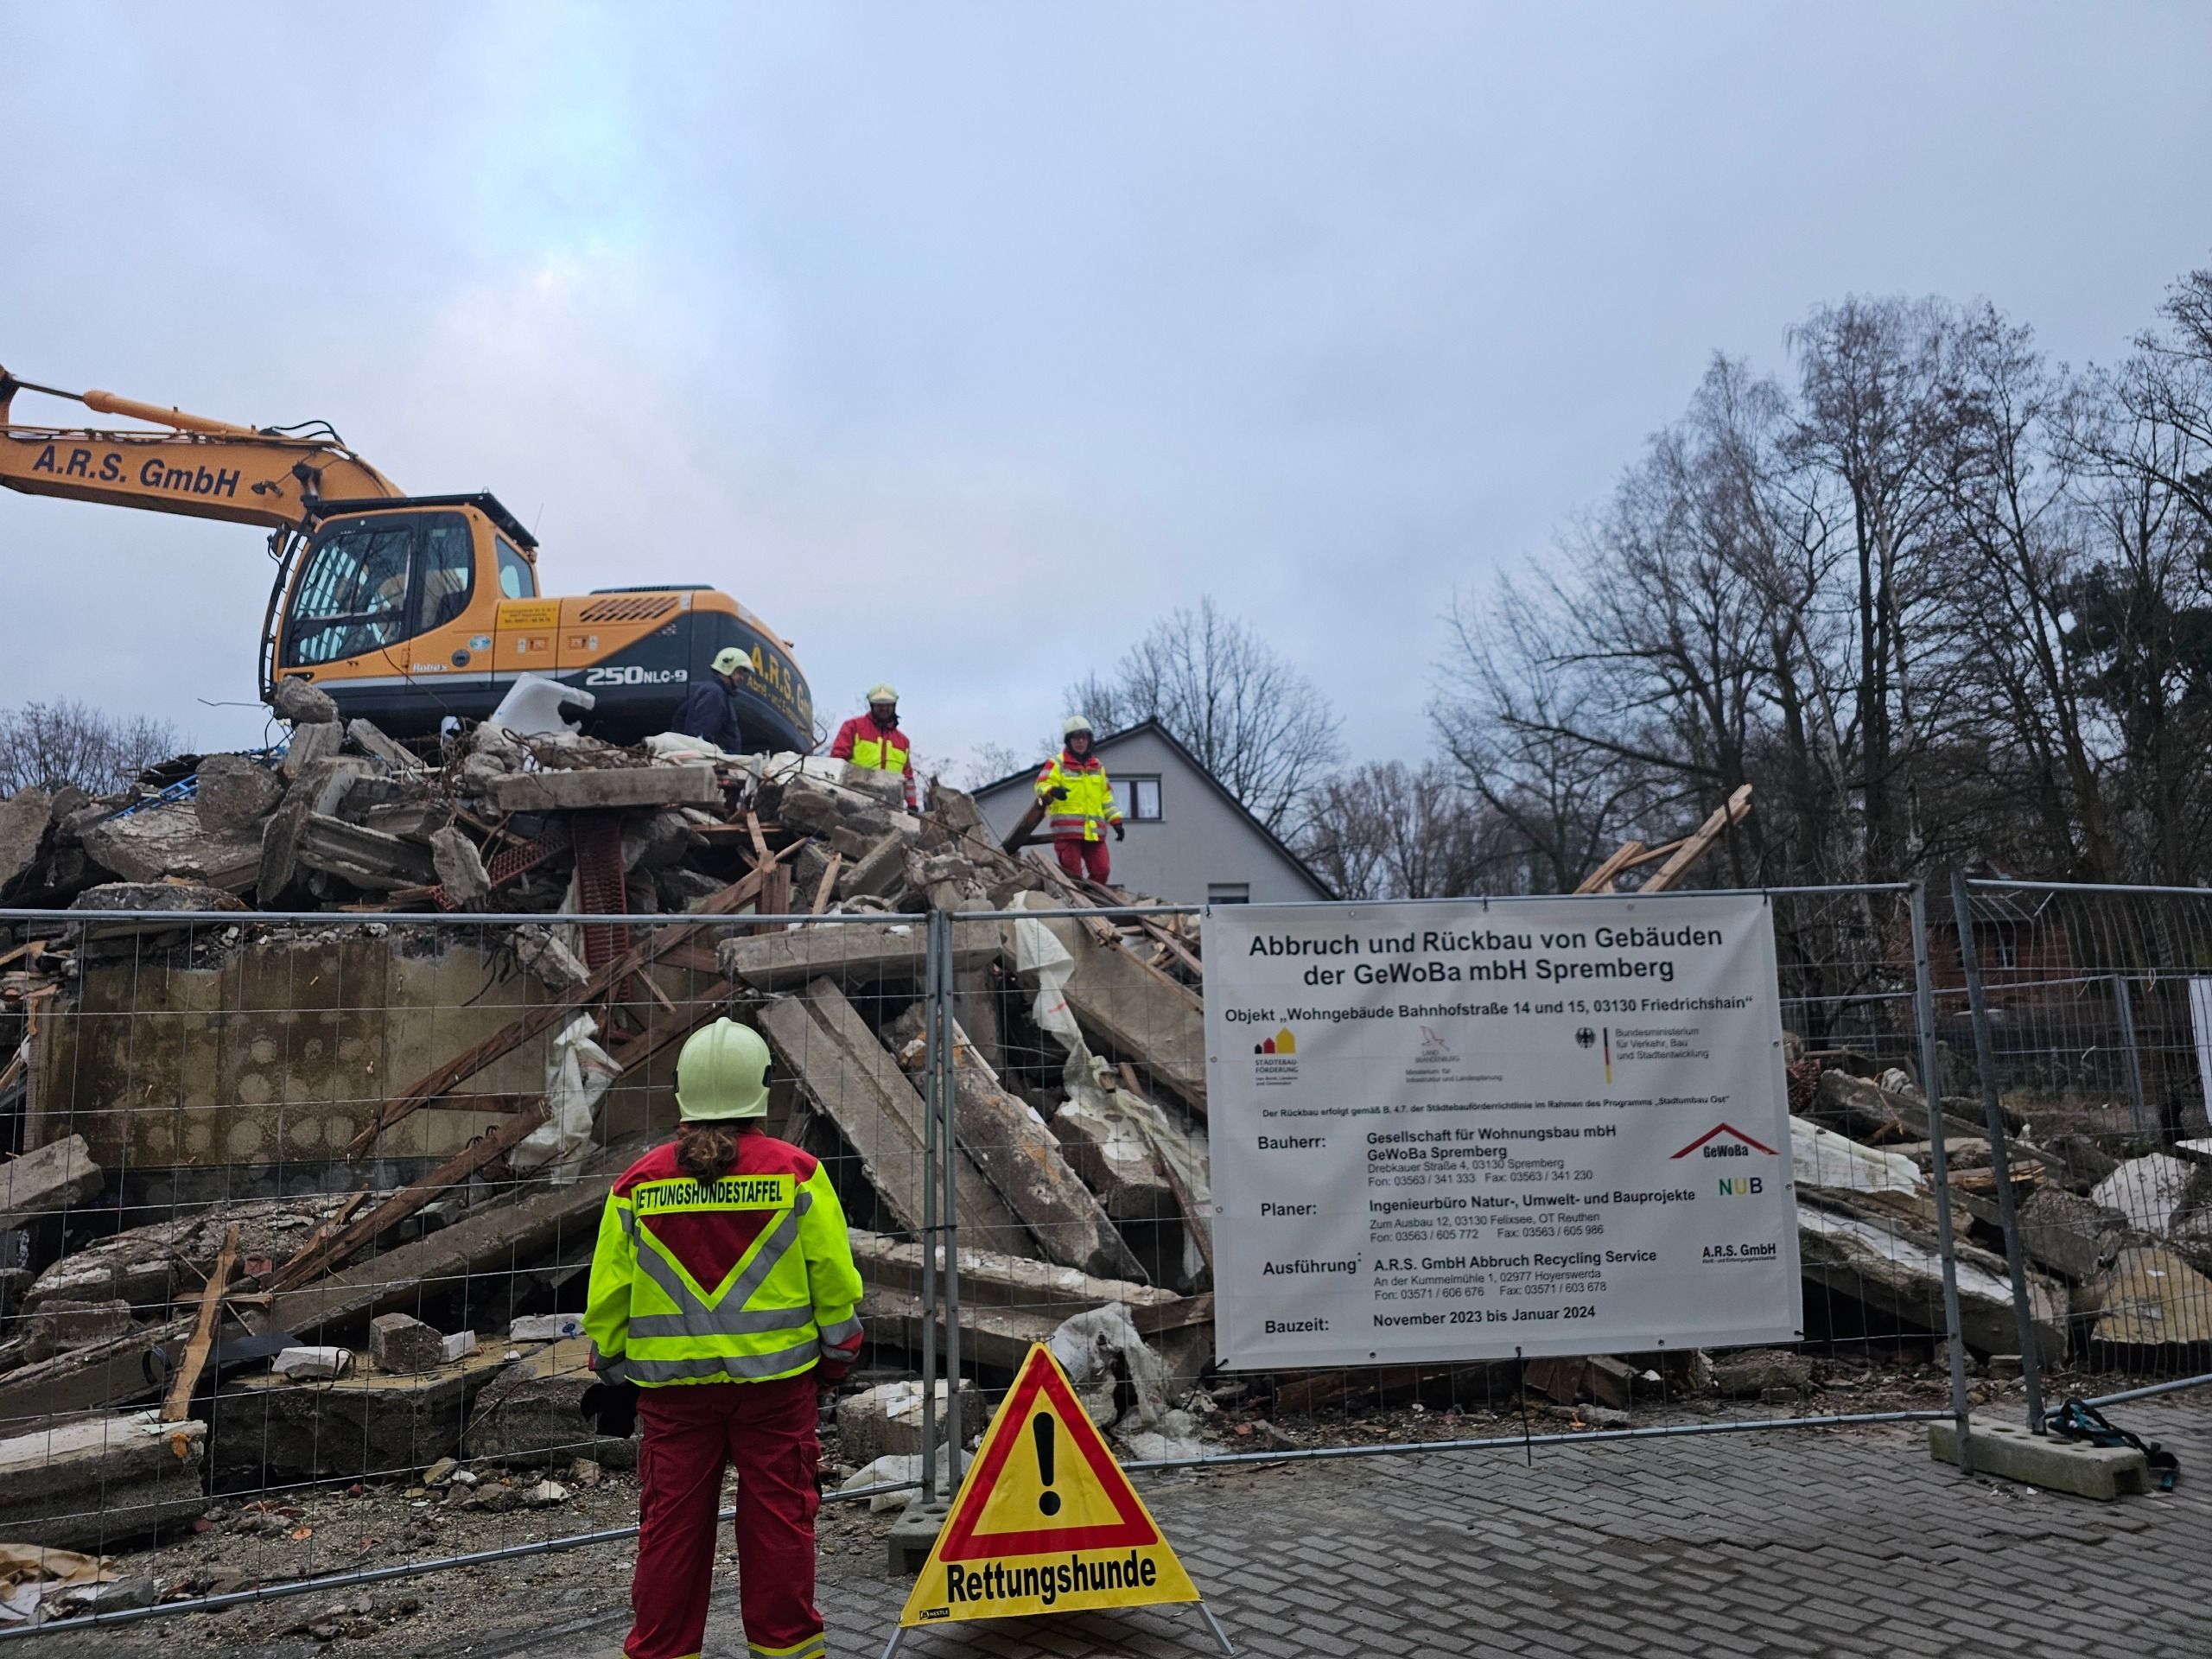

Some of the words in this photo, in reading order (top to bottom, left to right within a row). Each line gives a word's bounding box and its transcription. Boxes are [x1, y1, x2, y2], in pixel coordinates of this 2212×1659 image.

[33, 445, 126, 483] A.R.S.
[140, 459, 241, 498] GmbH
[750, 643, 795, 704] A.R.S.
[1249, 935, 1358, 956] Abbruch
[1370, 932, 1414, 953] und
[1423, 931, 1532, 951] Rückbau
[1541, 933, 1586, 949] von
[1595, 926, 1721, 947] Gebäuden
[1304, 965, 1345, 985] der
[1354, 962, 1461, 984] GeWoBa
[1470, 960, 1526, 981] mbH
[1536, 957, 1673, 983] Spremberg
[1225, 1009, 1274, 1024] Objekt
[1281, 1006, 1394, 1023] „Wohngebäude
[1399, 1002, 1508, 1017] Bahnhofstraße
[1514, 1002, 1530, 1014] 14
[1535, 1001, 1563, 1014] und
[1568, 1001, 1589, 1014] 15,
[1594, 1000, 1636, 1012] 03130
[1617, 1039, 1628, 1048] für
[1670, 1039, 1688, 1047] Bau
[1618, 1052, 1634, 1060] und
[1281, 1109, 1319, 1117] Rückbau
[1321, 1107, 1349, 1116] erfolgt
[1351, 1106, 1381, 1116] gemäß
[1603, 1099, 1652, 1108] Programms
[1258, 1135, 1325, 1149] Bauherr:
[1367, 1130, 1452, 1144] Gesellschaft
[1455, 1128, 1474, 1141] für
[1478, 1127, 1580, 1141] Wohnungsbau
[1584, 1125, 1616, 1137] mbH
[1368, 1147, 1427, 1160] GeWoBa
[1431, 1146, 1507, 1161] Spremberg
[1703, 1145, 1749, 1158] GeWoBa
[1368, 1163, 1421, 1173] Drebkauer
[1423, 1160, 1457, 1171] Straße
[1459, 1160, 1469, 1171] 4,
[1472, 1160, 1504, 1170] 03130
[1508, 1158, 1564, 1170] Spremberg
[1369, 1177, 1390, 1186] Fon:
[1394, 1175, 1425, 1185] 03563
[1434, 1174, 1452, 1184] 341
[1456, 1173, 1476, 1183] 333
[1484, 1173, 1507, 1182] Fax:
[1510, 1171, 1542, 1182] 03563
[1552, 1171, 1569, 1180] 341
[1573, 1170, 1592, 1180] 230
[1719, 1178, 1763, 1195] NUB
[1262, 1203, 1316, 1216] Planer:
[1370, 1198, 1466, 1214] Ingenieurbüro
[1471, 1196, 1518, 1208] Natur-,
[1523, 1194, 1580, 1206] Umwelt-
[1585, 1192, 1609, 1205] und
[1613, 1189, 1694, 1205] Bauprojekte
[1370, 1219, 1392, 1229] Zum
[1395, 1217, 1433, 1228] Ausbau
[1437, 1217, 1452, 1227] 12,
[1454, 1216, 1487, 1226] 03130
[1539, 1213, 1555, 1224] OT
[1558, 1212, 1599, 1223] Reuthen
[1370, 1233, 1392, 1243] Fon:
[1395, 1231, 1427, 1242] 03563
[1436, 1230, 1456, 1240] 605
[1459, 1229, 1478, 1239] 772
[1497, 1228, 1520, 1238] Fax:
[1522, 1226, 1554, 1237] 03563
[1564, 1226, 1583, 1236] 605
[1586, 1224, 1604, 1235] 986
[1703, 1246, 1737, 1257] A.R.S.
[1740, 1243, 1776, 1255] GmbH
[1375, 1258, 1416, 1271] A.R.S.
[1421, 1256, 1465, 1269] GmbH
[1470, 1255, 1529, 1268] Abbruch
[1535, 1252, 1600, 1268] Recycling
[1605, 1250, 1656, 1262] Service
[1374, 1277, 1388, 1287] An
[1391, 1276, 1408, 1286] der
[1489, 1273, 1497, 1283] 1,
[1500, 1272, 1532, 1282] 02977
[1535, 1269, 1601, 1282] Hoyerswerda
[1375, 1290, 1397, 1300] Fon:
[1401, 1288, 1433, 1300] 03571
[1442, 1287, 1461, 1298] 606
[1465, 1287, 1484, 1297] 676
[1499, 1285, 1522, 1295] Fax:
[1524, 1284, 1555, 1294] 03571
[1565, 1283, 1585, 1293] 603
[1587, 1281, 1607, 1292] 678
[1374, 1313, 1446, 1326] November
[1450, 1311, 1482, 1323] 2023
[1487, 1310, 1507, 1322] bis
[1512, 1309, 1560, 1320] Januar
[1564, 1306, 1596, 1319] 2024
[1266, 1318, 1328, 1333] Bauzeit:
[947, 1549, 1156, 1605] Rettungshunde
